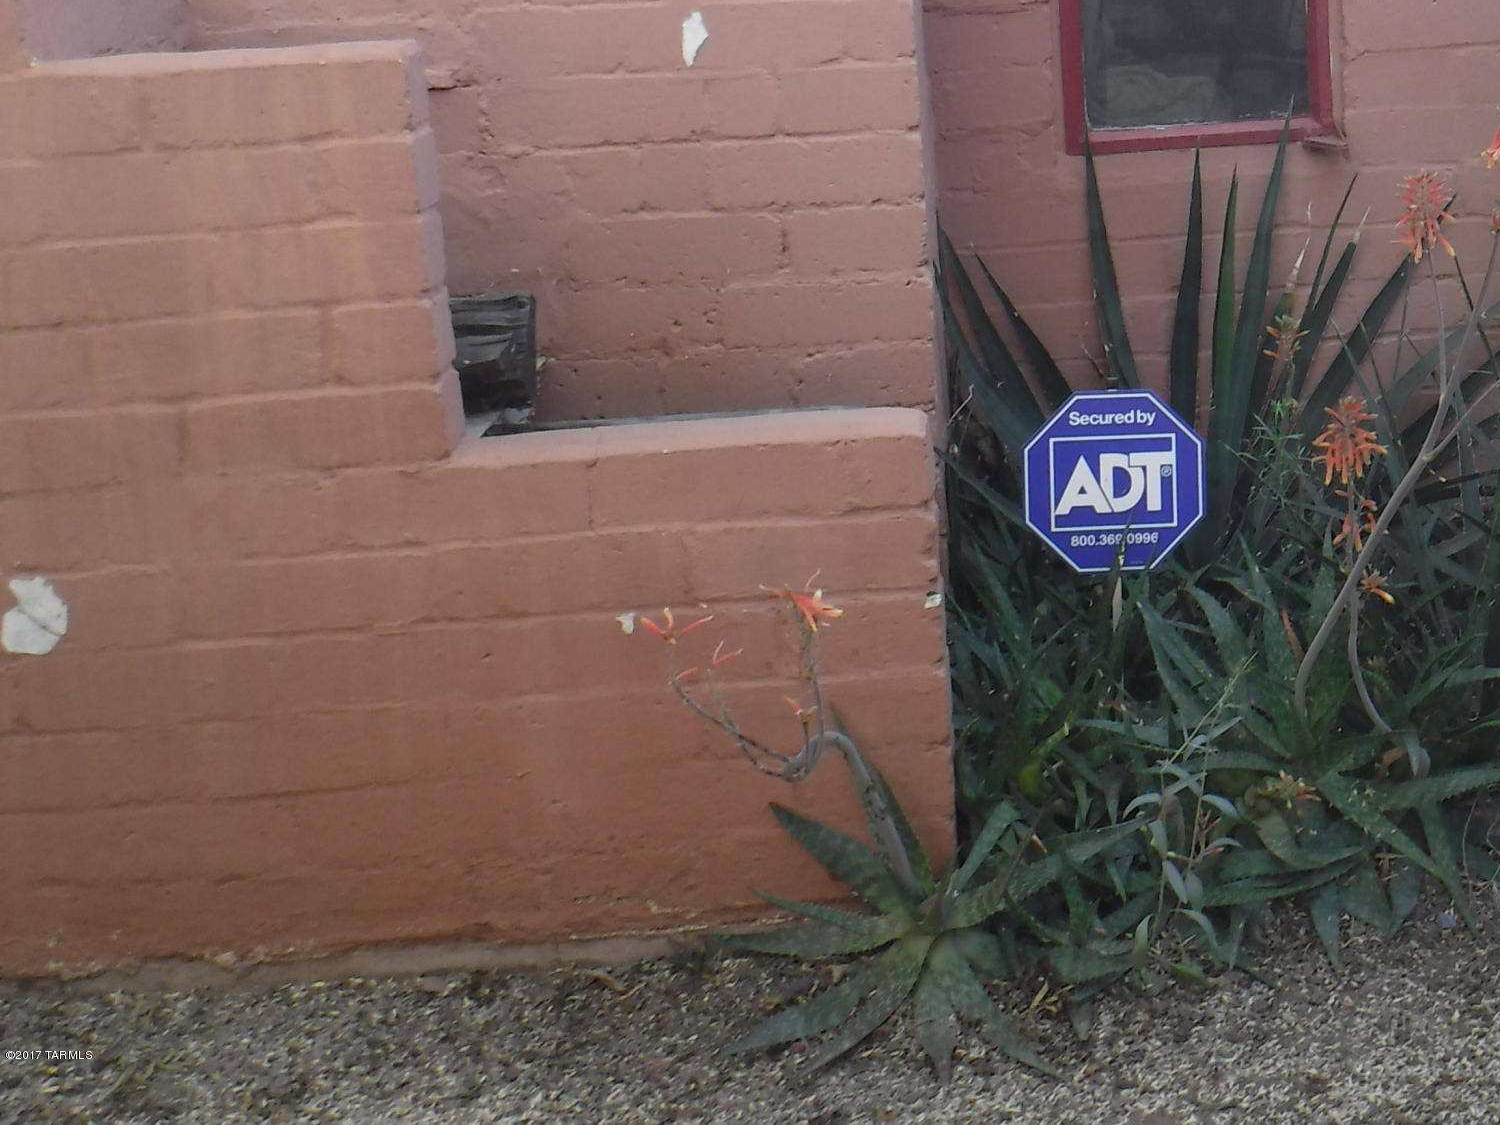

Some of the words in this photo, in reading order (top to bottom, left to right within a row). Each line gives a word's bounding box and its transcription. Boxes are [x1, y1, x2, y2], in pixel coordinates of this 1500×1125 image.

[1068, 409, 1135, 426] Secured
[1136, 409, 1157, 426] by
[1070, 532, 1159, 547] 800.3690996
